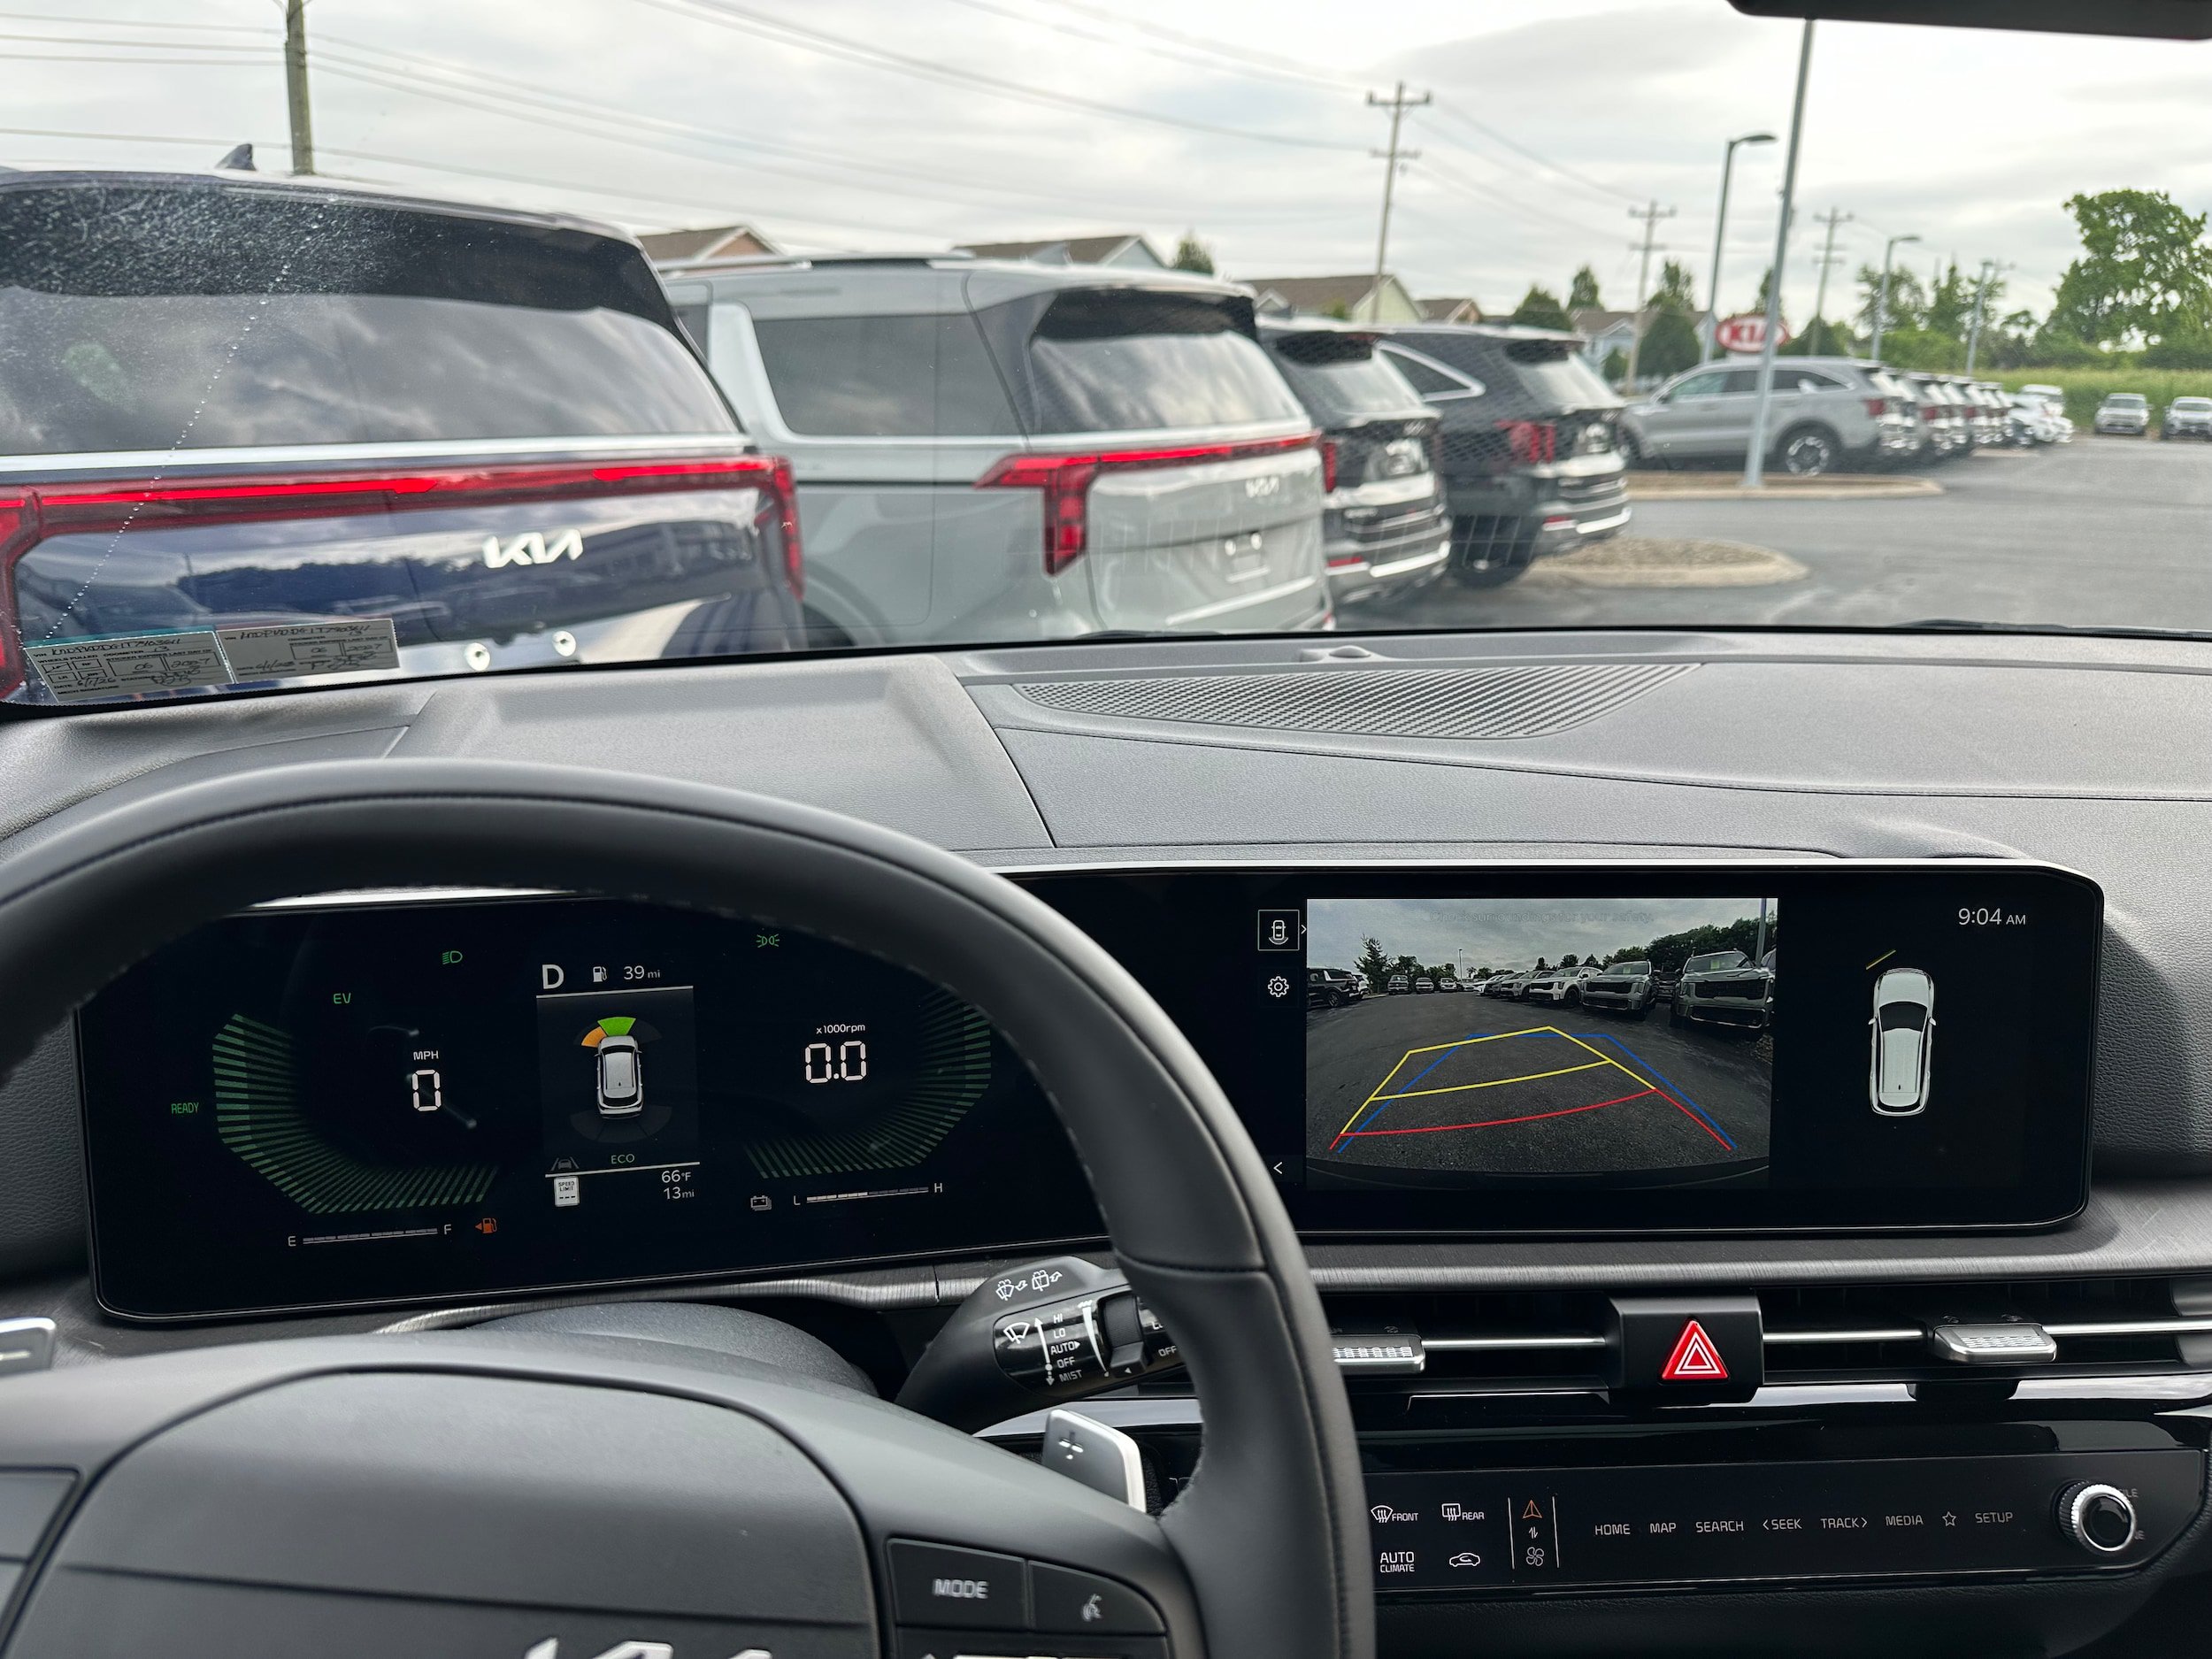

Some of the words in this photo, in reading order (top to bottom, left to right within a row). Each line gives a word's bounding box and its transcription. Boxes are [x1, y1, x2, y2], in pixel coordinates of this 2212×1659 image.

[481, 529, 583, 568] KIA
[1958, 908, 2002, 926] 9:04
[2006, 914, 2026, 925] AM
[541, 964, 565, 990] D
[333, 993, 351, 1004] EV
[816, 1024, 866, 1034] x1000rpm
[413, 1050, 439, 1061] MPH
[804, 1041, 867, 1084] 0.0
[412, 1069, 442, 1112] 0
[171, 1102, 199, 1115] READY
[611, 1154, 635, 1164] ECO
[933, 1182, 943, 1194] H
[793, 1195, 801, 1206] L
[443, 1224, 452, 1235] F
[288, 1236, 296, 1247] E
[1053, 1314, 1063, 1324] HI
[1053, 1328, 1066, 1339] LO
[1050, 1341, 1076, 1356] AUTO
[1157, 1345, 1178, 1357] OFF
[1056, 1356, 1076, 1369] OFF
[1058, 1369, 1083, 1382] MIST
[1391, 1512, 1418, 1522] FRONT
[1462, 1511, 1485, 1521] REAR
[1594, 1524, 1631, 1535] HOME
[1649, 1522, 1677, 1533] MAP
[1695, 1520, 1744, 1532] SEARCH
[1885, 1514, 1924, 1526] MEDIA
[1975, 1511, 2013, 1524] SETUP
[1380, 1551, 1415, 1563] AUTO
[1379, 1563, 1415, 1573] CLIMATE
[933, 1578, 988, 1599] MODE
